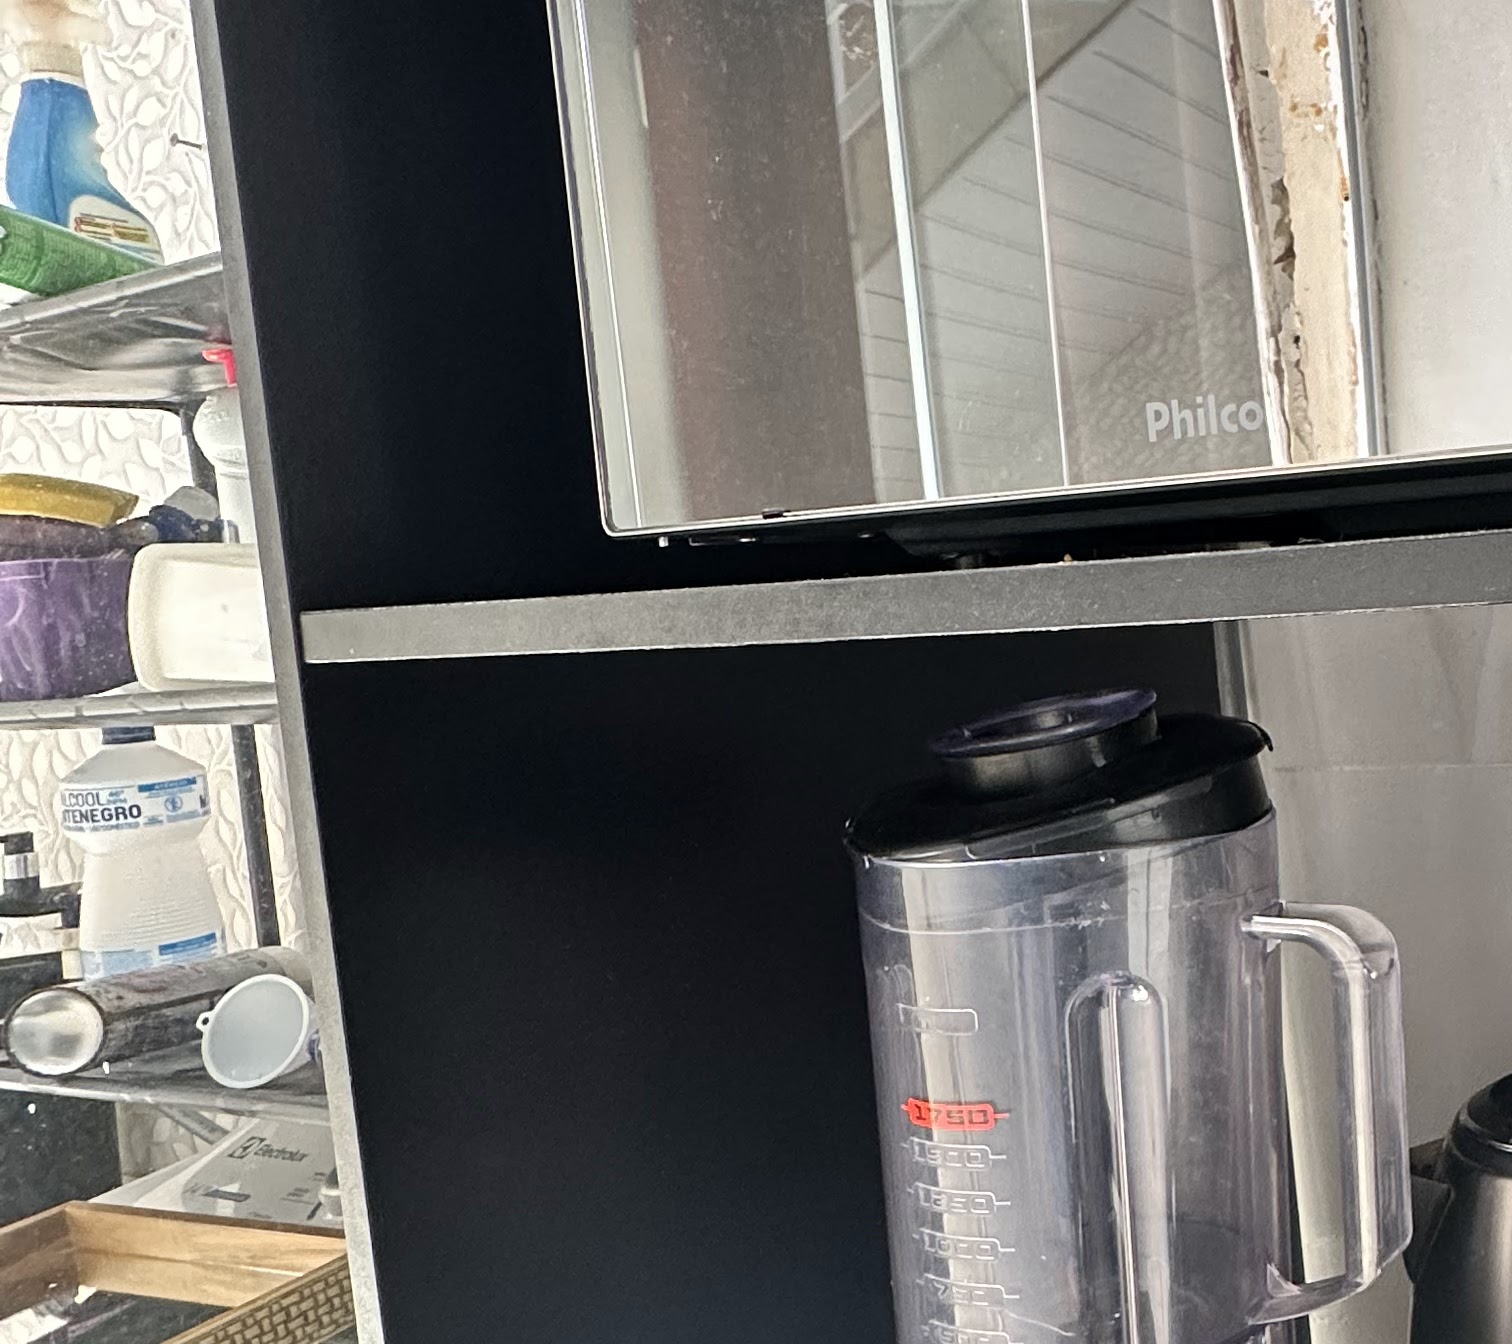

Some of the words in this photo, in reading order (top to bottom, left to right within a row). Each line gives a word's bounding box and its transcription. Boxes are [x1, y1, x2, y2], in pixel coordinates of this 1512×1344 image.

[1145, 394, 1264, 443] Philco
[61, 791, 105, 808] LCOOL
[915, 1104, 990, 1125] 1750
